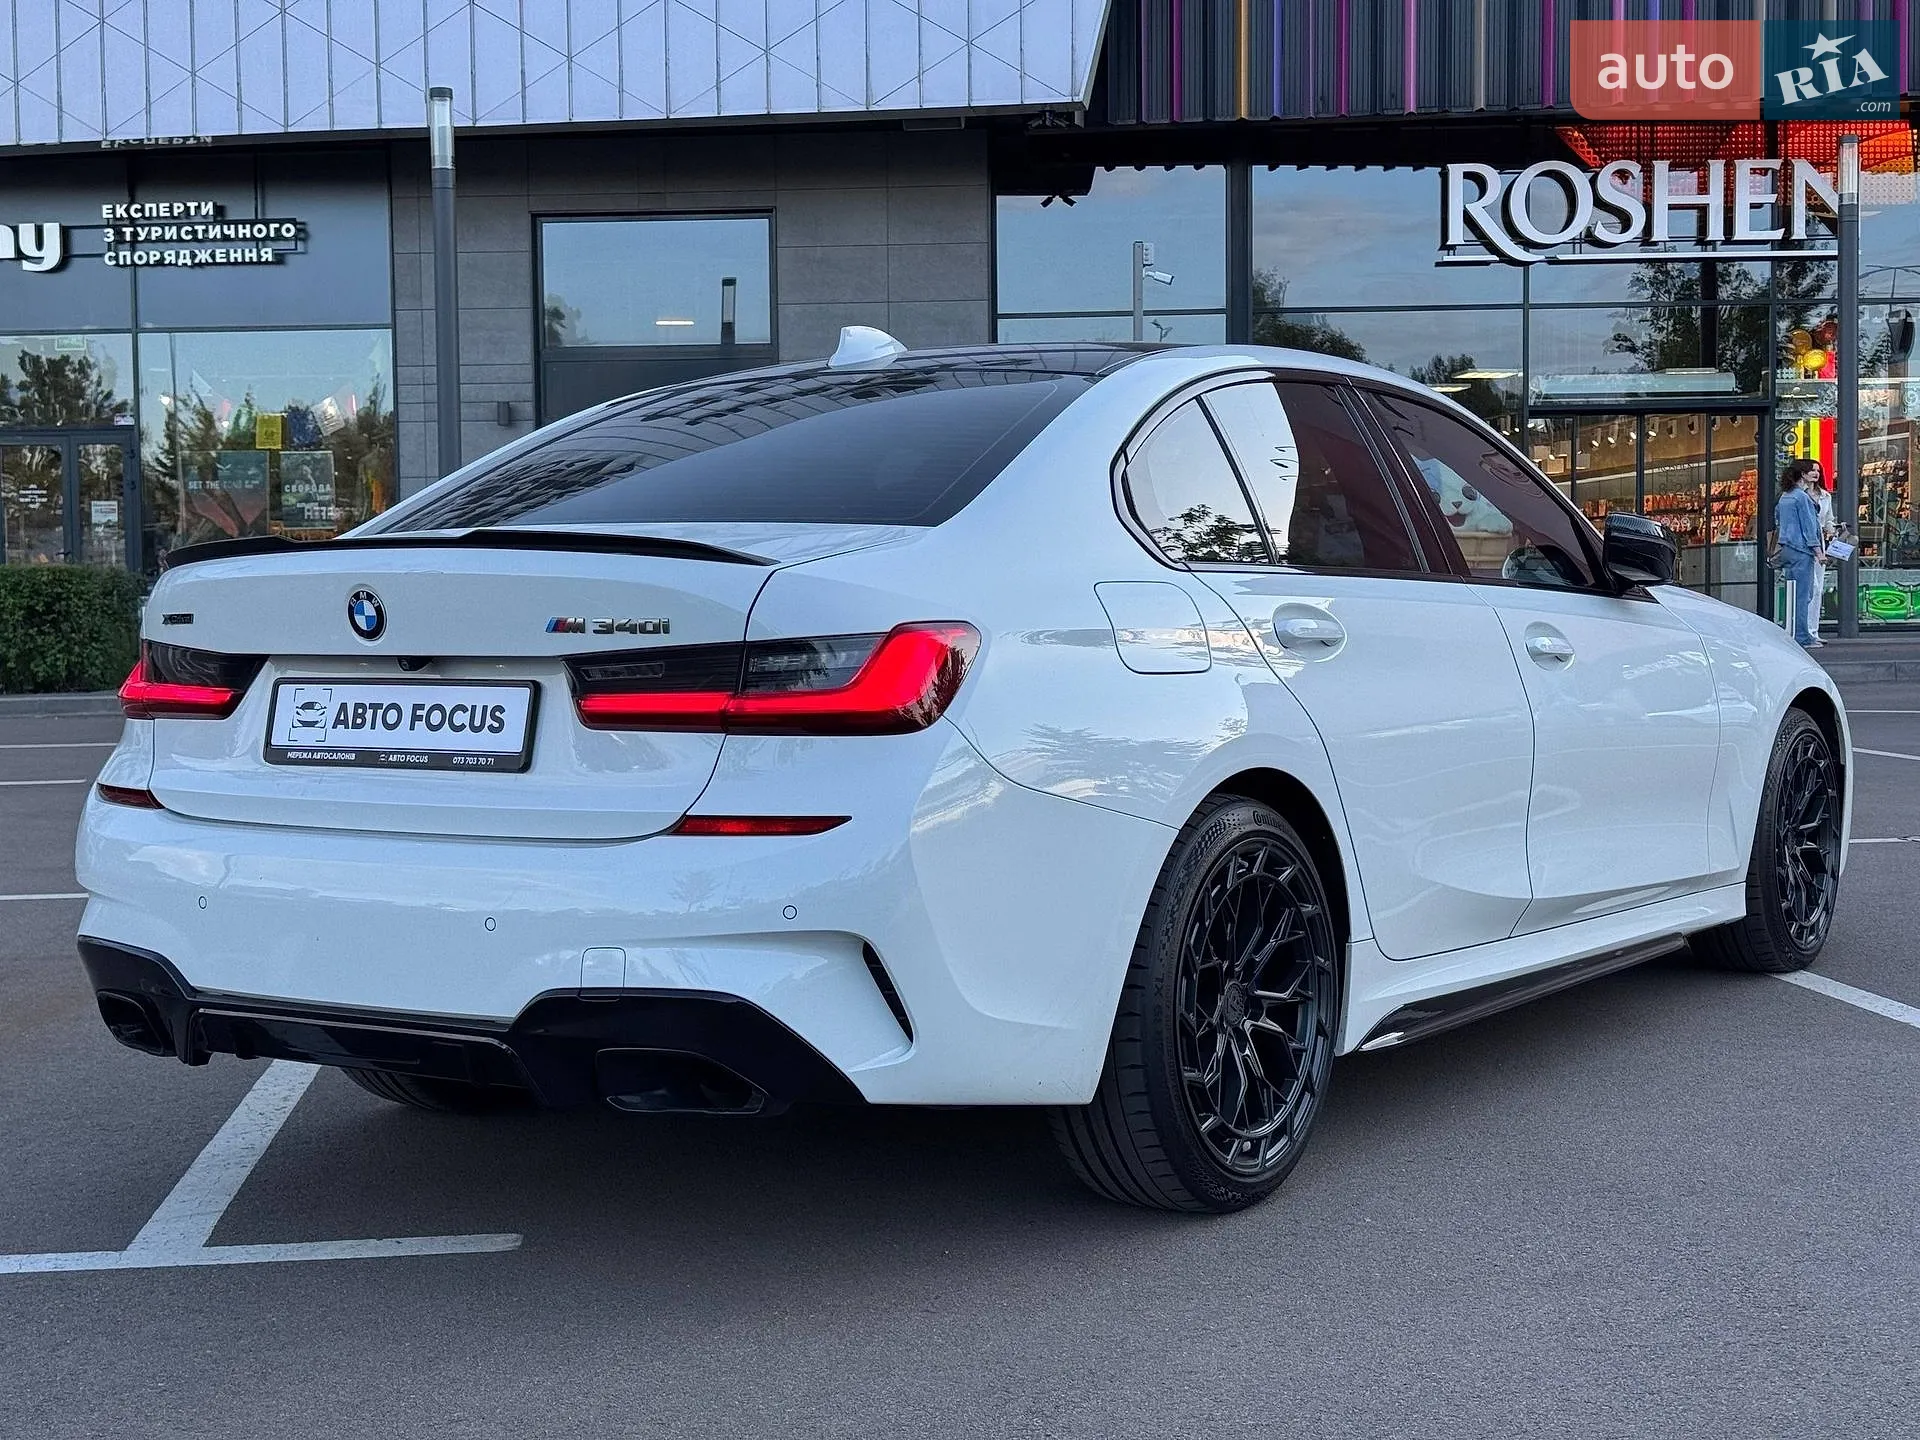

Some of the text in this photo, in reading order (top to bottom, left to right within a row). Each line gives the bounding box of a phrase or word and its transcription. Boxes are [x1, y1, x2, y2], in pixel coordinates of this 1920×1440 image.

[102, 201, 214, 219] ЕКСПЕРТИ
[1445, 160, 1839, 262] ROSHEN
[122, 223, 296, 242] ТУРИСТИЧНОГО
[104, 247, 273, 265] СПОРЯДЖЕННЯ
[332, 702, 506, 734] АВТО FOCUS
[287, 751, 311, 759] МЕРЕЖА
[406, 754, 428, 763] FOCUS
[452, 756, 494, 765] 073 703 70 71
